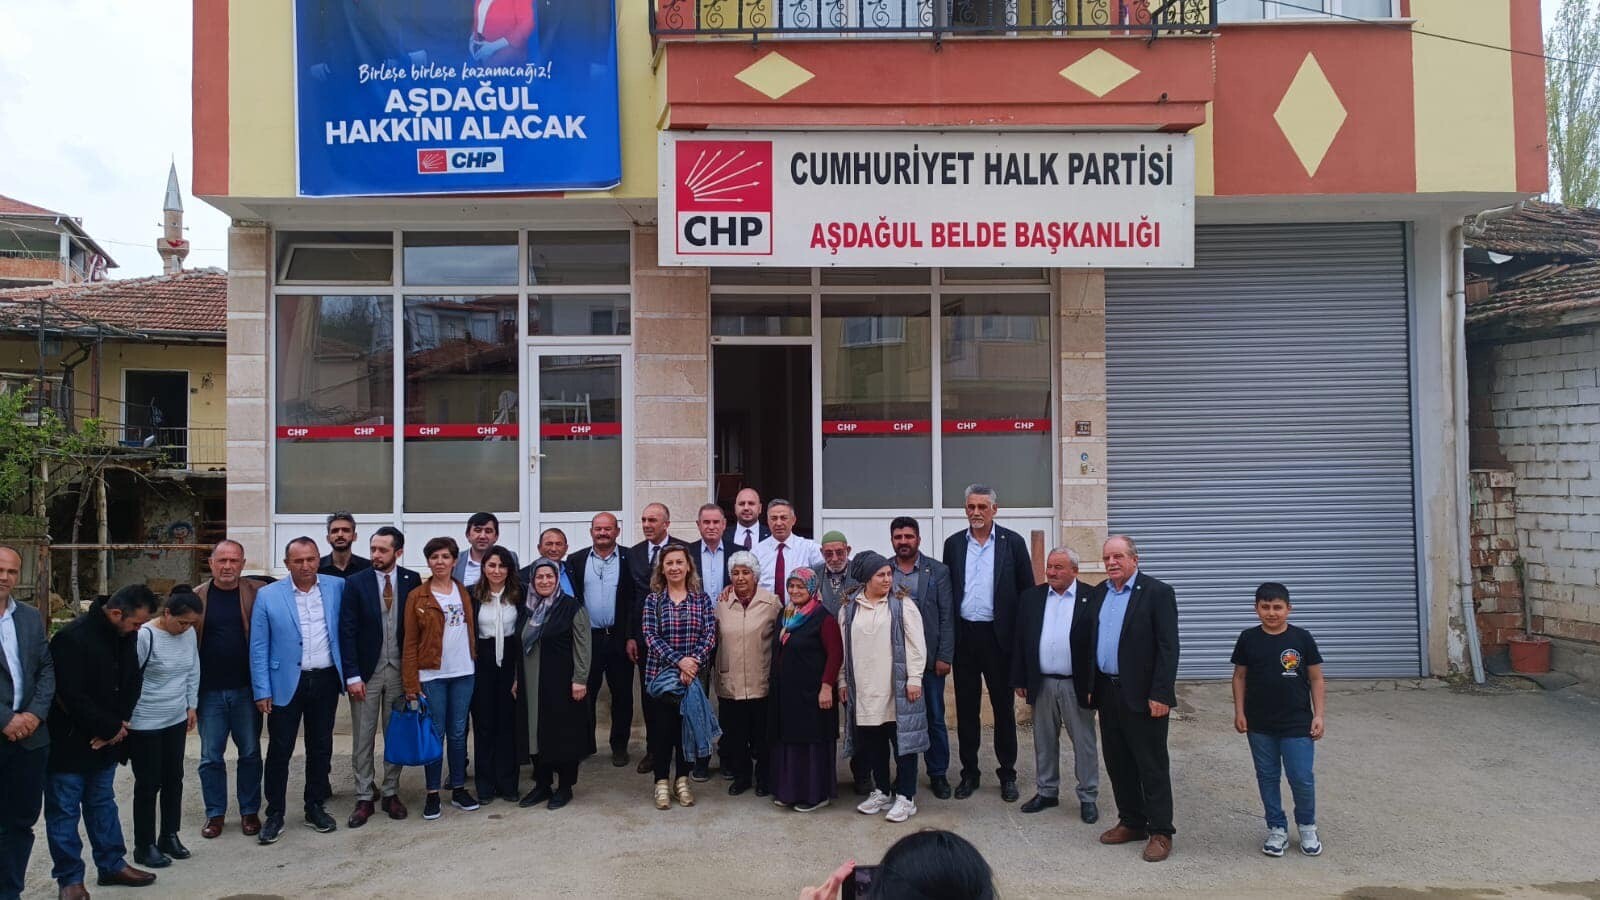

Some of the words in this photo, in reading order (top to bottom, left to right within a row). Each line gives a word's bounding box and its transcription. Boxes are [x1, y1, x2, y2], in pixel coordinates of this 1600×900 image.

[358, 62, 407, 84] Birleşe
[411, 62, 457, 81] birleşe
[462, 60, 553, 85] kazanacağız!
[384, 80, 539, 117] AŞDAĞUL
[325, 117, 452, 145] HAKKINI
[459, 115, 587, 141] ALACAK
[451, 151, 497, 169] CHP
[790, 143, 975, 186] CUMHURİYET
[984, 152, 1060, 186] HALK
[1068, 144, 1173, 186] PARTİSİ
[683, 215, 763, 247] CHP
[809, 216, 923, 256] AŞDAĞUL
[930, 221, 1007, 249] BELDE
[1014, 216, 1161, 256] BAŞKANLIĞI
[570, 425, 592, 434] CHP
[836, 423, 857, 432] CHP
[893, 422, 914, 431] CHP
[956, 421, 978, 431] CHP
[1013, 421, 1035, 430] CHP
[287, 428, 309, 437] CHP
[353, 427, 375, 436] CHP
[419, 427, 441, 436] CHP
[476, 426, 498, 435] CHP
